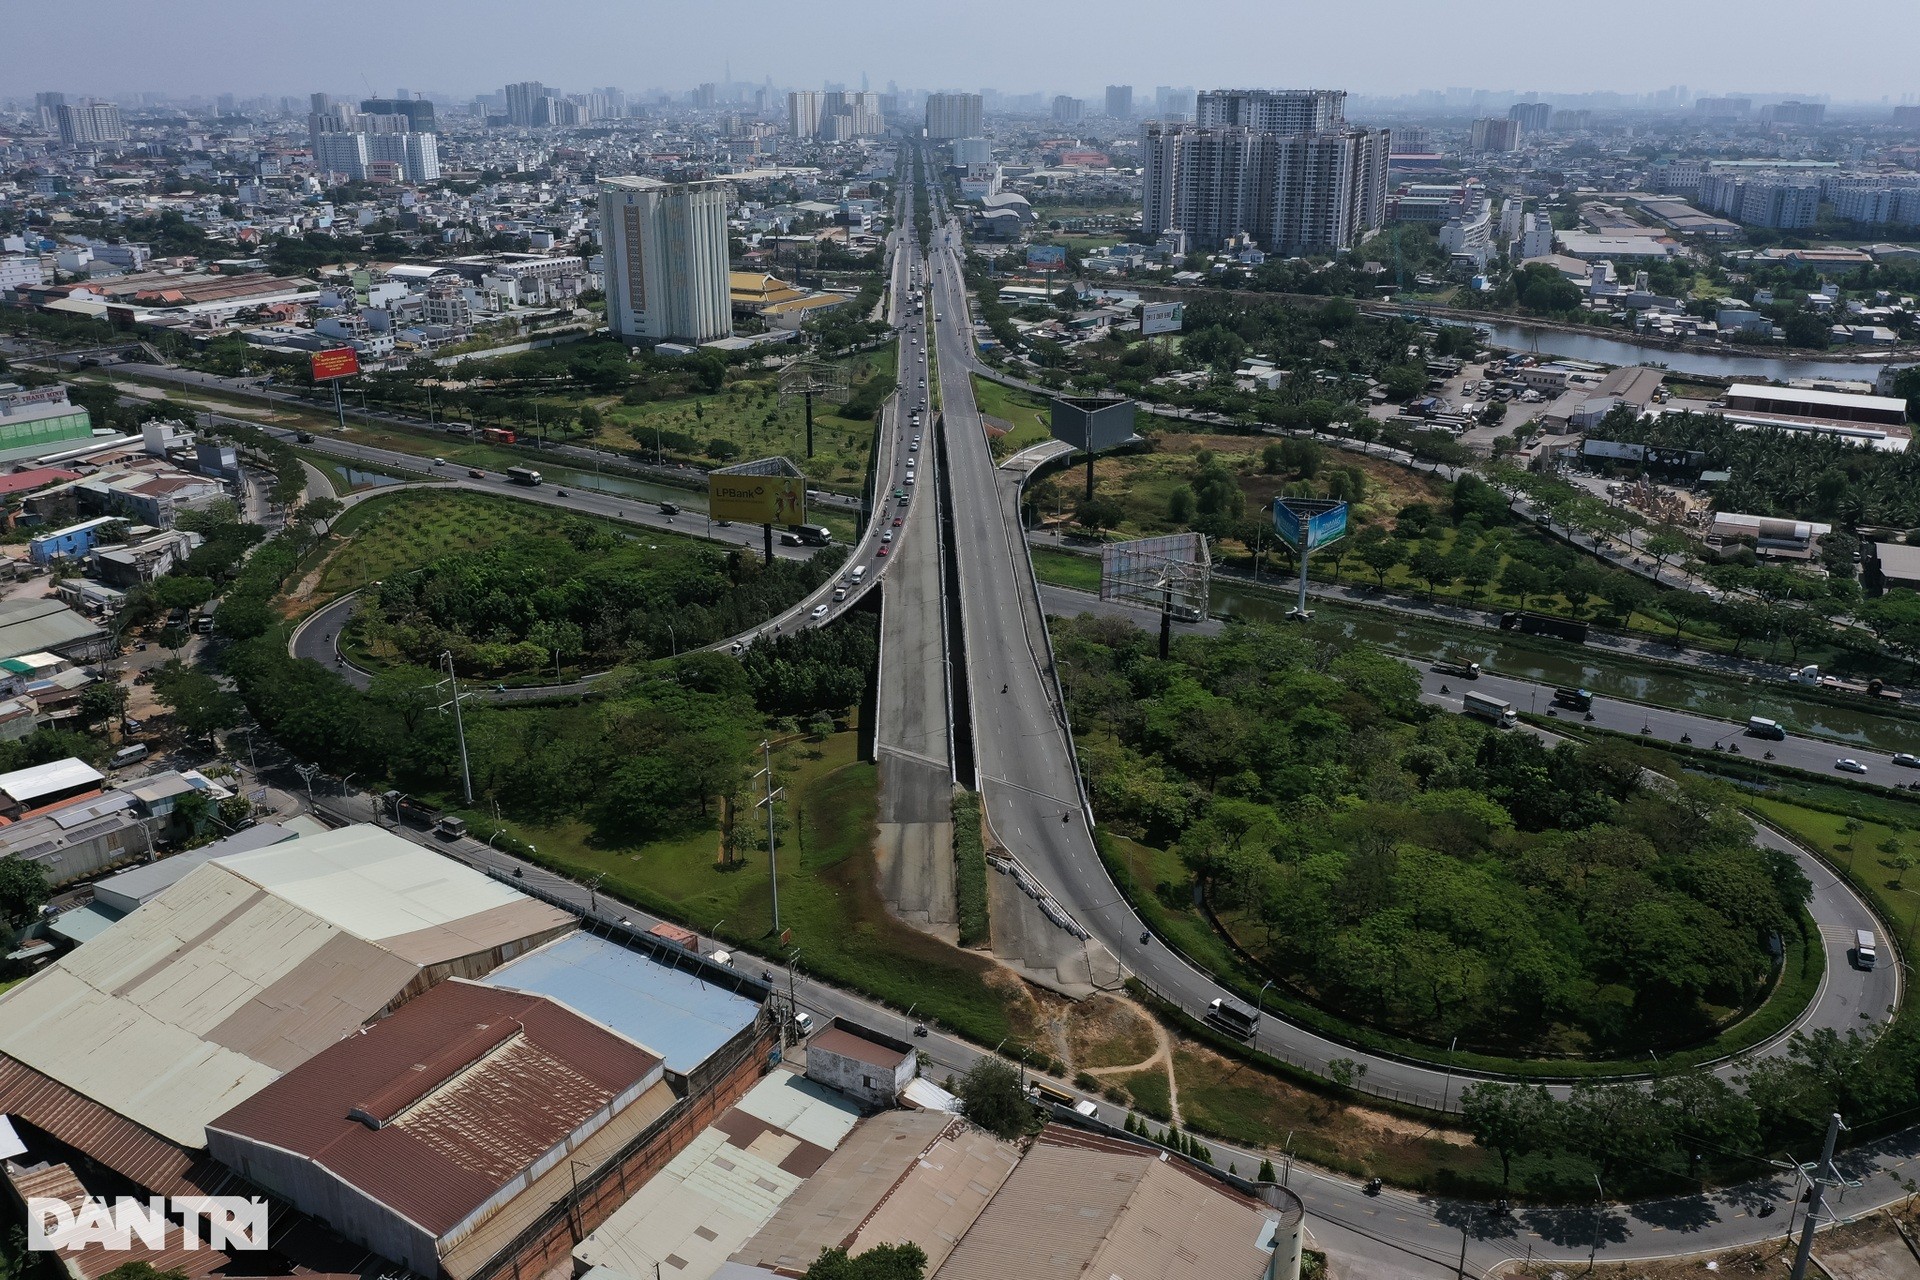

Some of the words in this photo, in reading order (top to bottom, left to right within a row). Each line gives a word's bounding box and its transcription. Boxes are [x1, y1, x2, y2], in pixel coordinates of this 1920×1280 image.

[22, 393, 45, 402] THANH
[47, 390, 64, 398] MINH
[716, 487, 755, 498] LPBank
